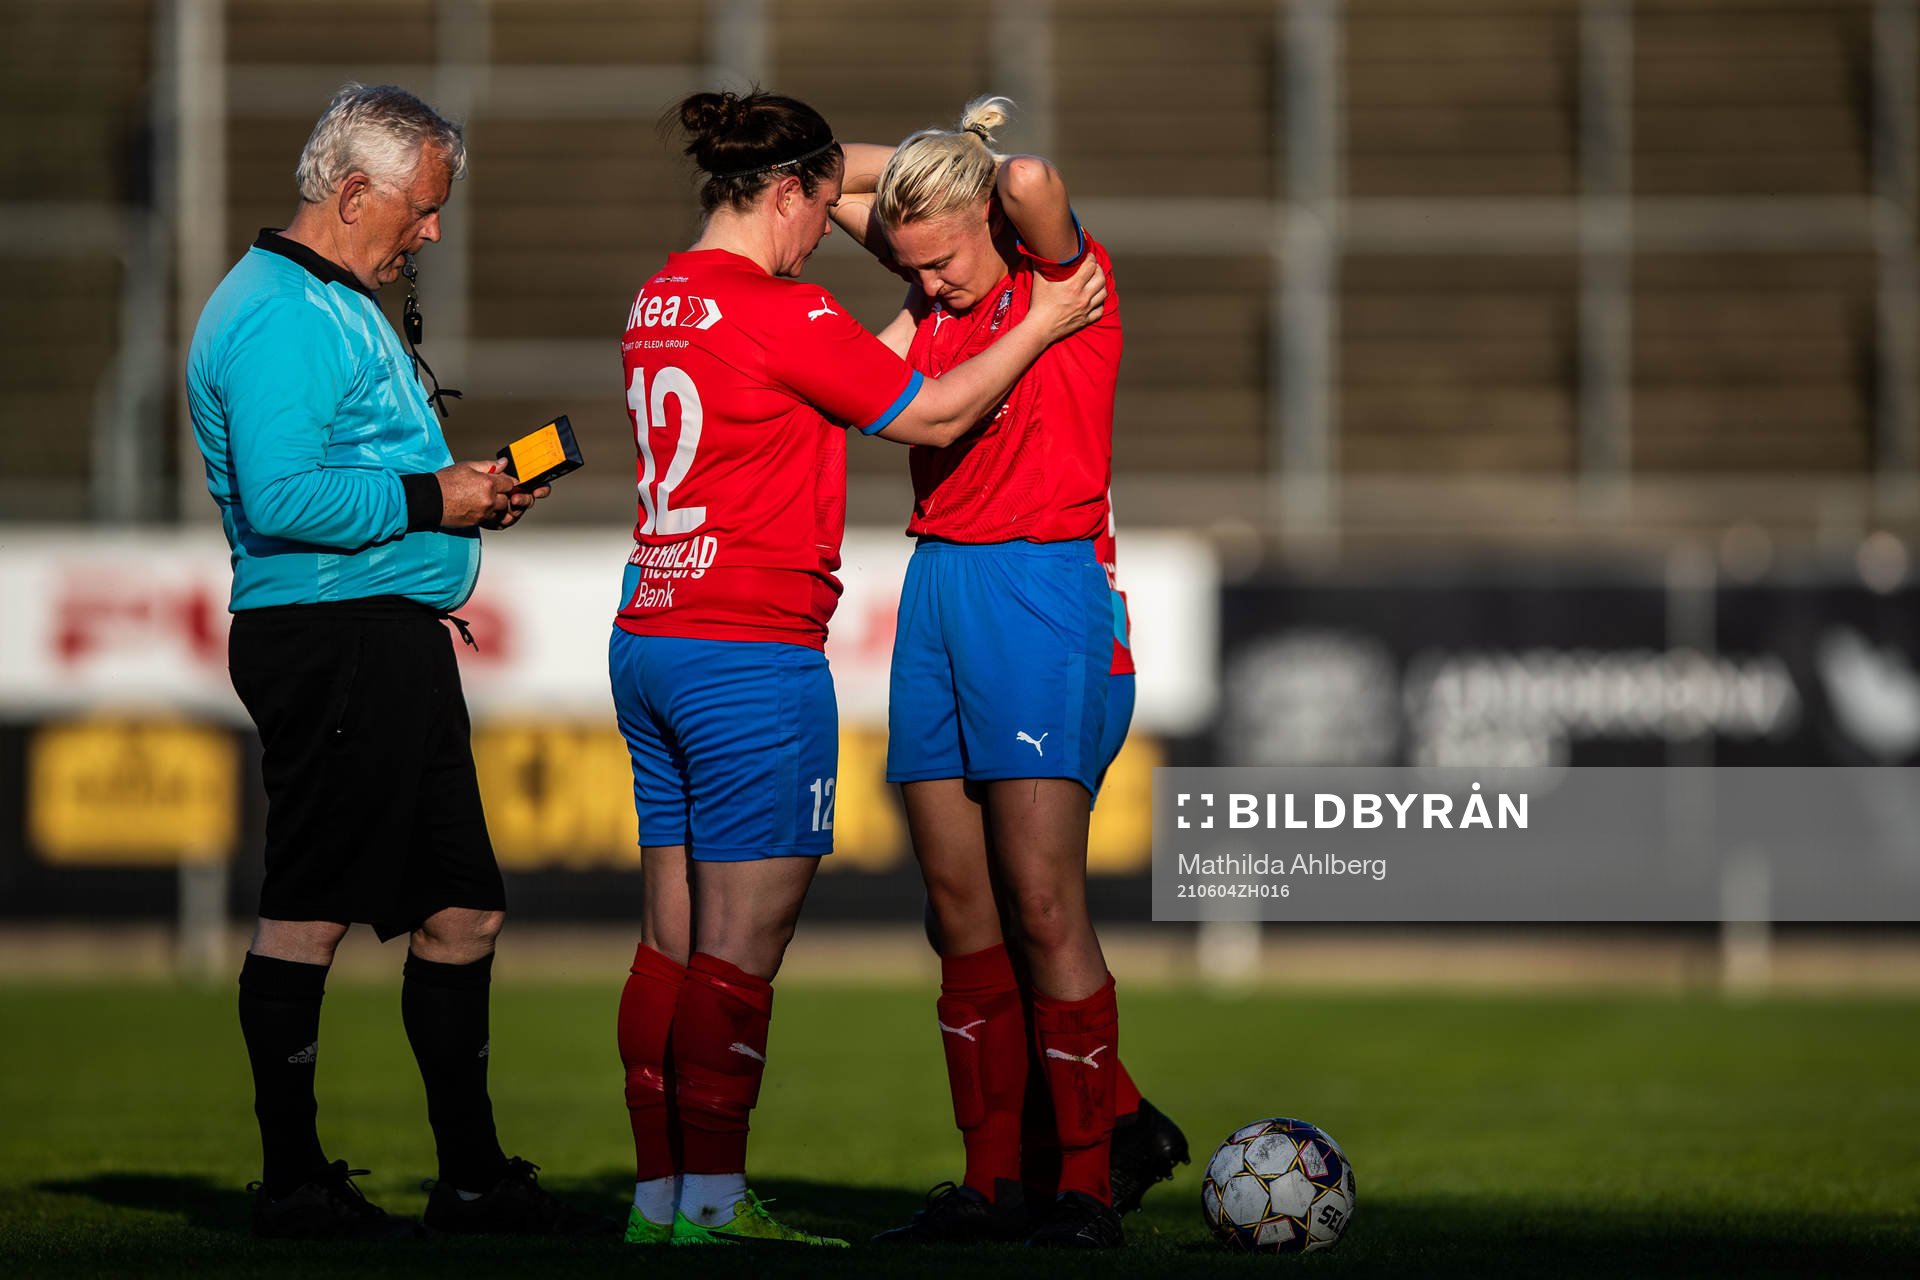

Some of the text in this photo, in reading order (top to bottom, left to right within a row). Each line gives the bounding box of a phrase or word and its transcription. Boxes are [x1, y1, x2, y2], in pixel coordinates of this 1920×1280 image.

[635, 341, 643, 349] OF
[644, 340, 664, 349] ELEDA
[665, 340, 690, 349] GROUP
[626, 366, 707, 536] 12
[628, 535, 718, 569] ESTERBLAD
[634, 580, 676, 608] Bank
[810, 777, 836, 832] 12
